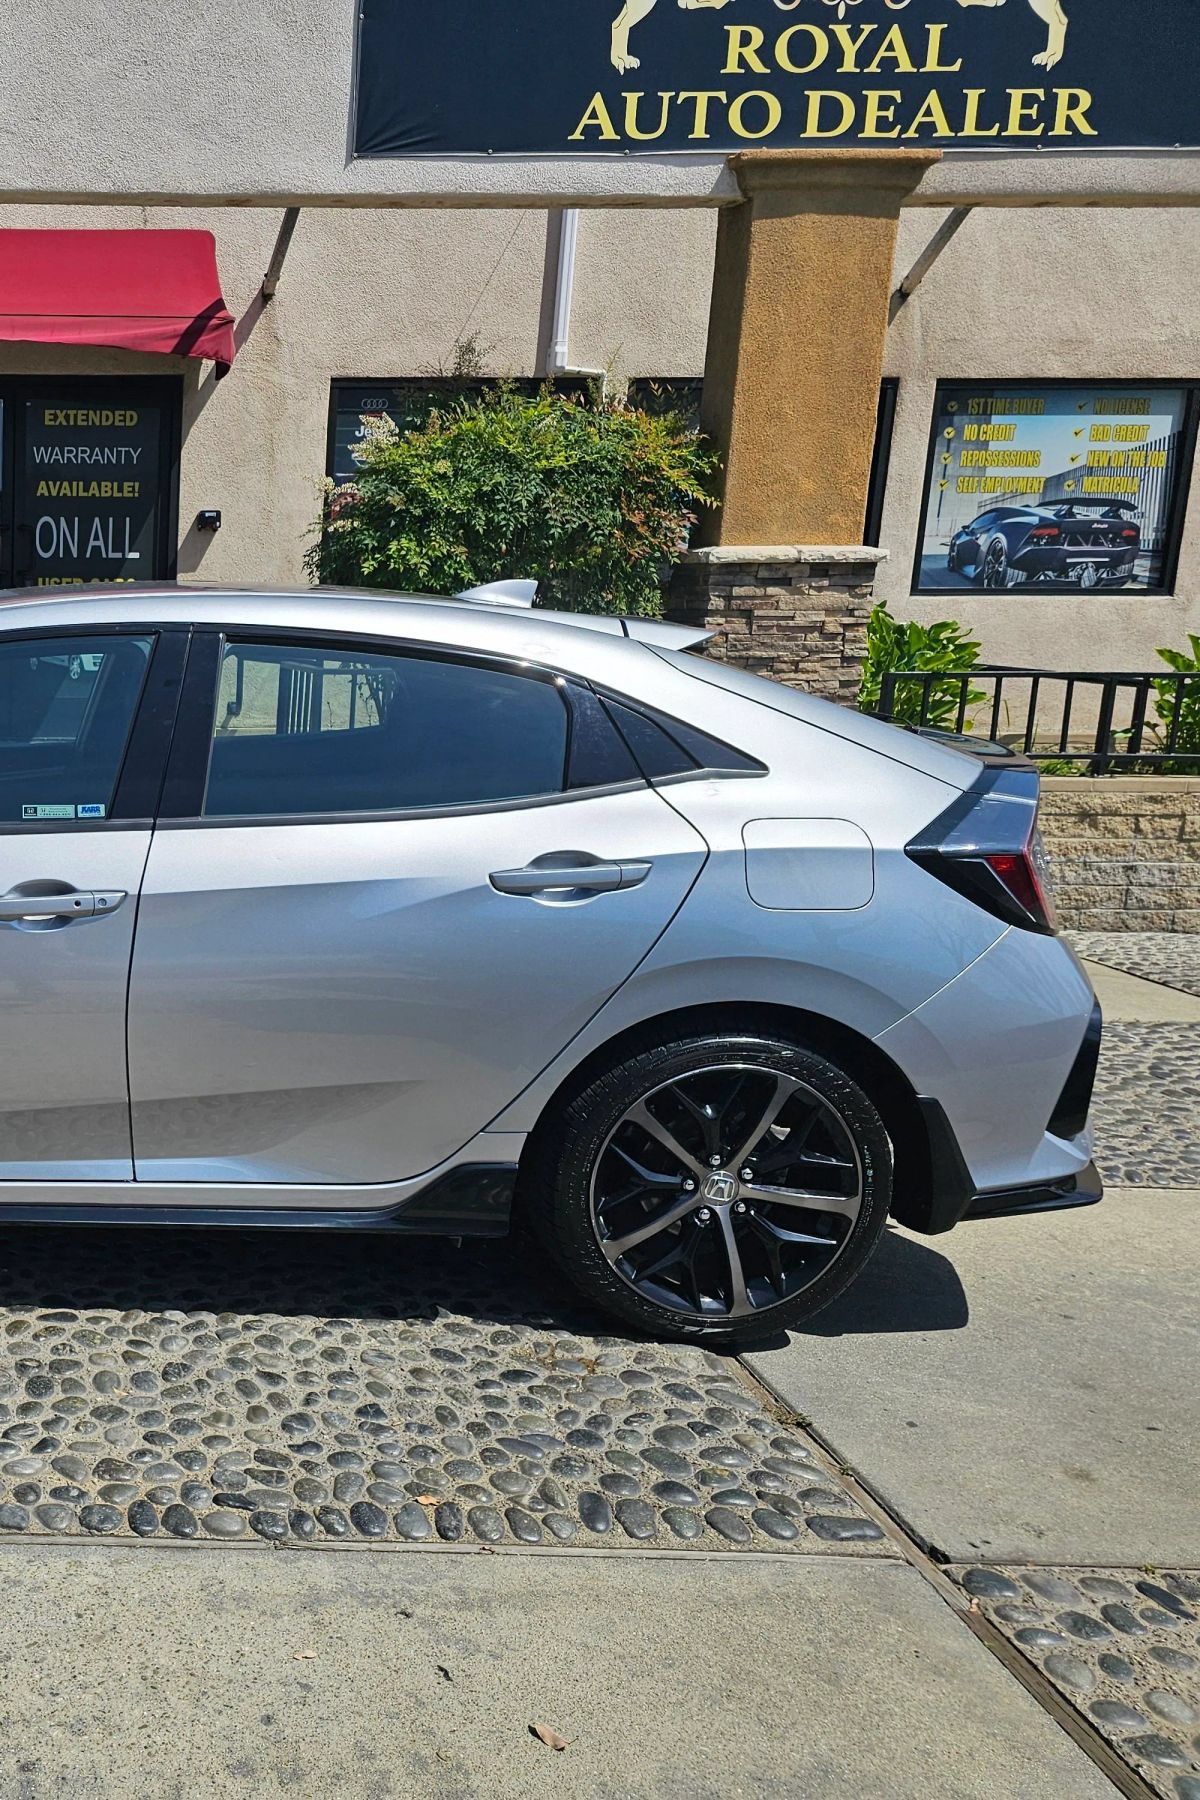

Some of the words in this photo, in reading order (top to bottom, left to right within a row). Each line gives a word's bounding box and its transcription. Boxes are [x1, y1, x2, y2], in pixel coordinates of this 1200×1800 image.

[720, 22, 963, 74] ROYAL
[567, 90, 782, 142] AUTO
[800, 87, 1099, 139] DEALER
[967, 398, 985, 415] 1ST
[986, 398, 1011, 415] TIME
[1012, 398, 1046, 415] BUYER
[43, 409, 138, 428] EXTENDED
[963, 424, 979, 441] NO
[979, 424, 1017, 441] CREDIT
[1090, 424, 1111, 441] BAD
[1112, 424, 1150, 442] CREDIT
[33, 446, 142, 465] WARRANTY
[959, 450, 1041, 468] REPOSSESSIONS
[1086, 450, 1111, 468] NEW
[1111, 450, 1126, 468] ON
[1127, 450, 1146, 468] THE
[1147, 450, 1167, 468] JOB
[36, 480, 140, 499] AVAILABLE!
[956, 476, 979, 494] SELF
[980, 476, 1047, 494] EMPLOYMENT
[1082, 476, 1140, 494] MATRICULA
[35, 514, 83, 559] ON
[85, 514, 141, 559] ALL
